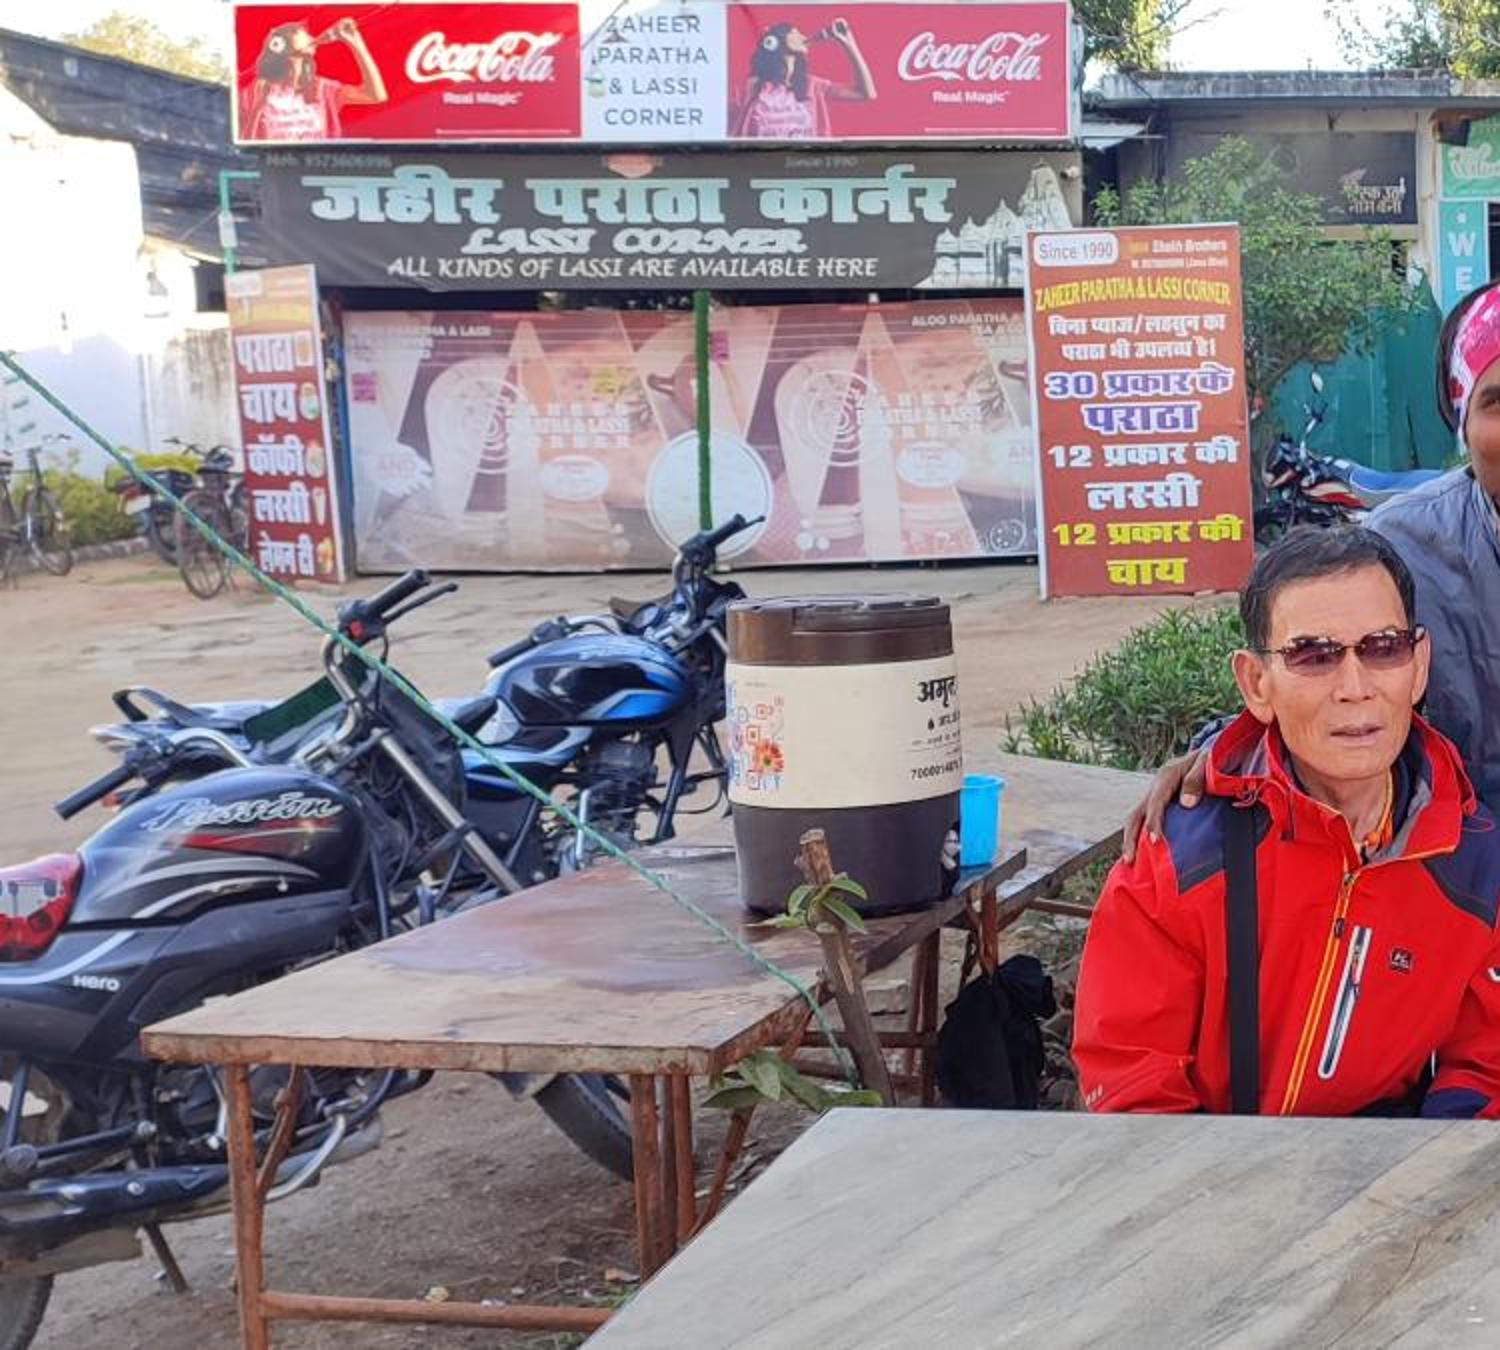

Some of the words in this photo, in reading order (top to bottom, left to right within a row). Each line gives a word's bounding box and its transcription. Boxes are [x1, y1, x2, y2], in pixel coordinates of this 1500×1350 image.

[605, 15, 702, 34] ZAHEER
[405, 31, 567, 84] Coca-Cola
[597, 46, 710, 66] PARATHA
[896, 31, 1052, 82] Coca-Cola
[608, 77, 624, 96] &
[631, 77, 699, 96] LASSI
[932, 90, 962, 104] Real
[603, 107, 704, 127] CORNER
[301, 164, 504, 225] जहीर
[524, 176, 730, 225] पराठा
[750, 163, 957, 224] कार्नर
[461, 227, 597, 255] LASSI
[612, 227, 809, 254] CORNER
[1039, 238, 1077, 260] Since
[1082, 241, 1114, 258] 1990
[387, 257, 432, 278] ALL
[438, 257, 514, 279] KINDS
[519, 257, 553, 278] OF
[558, 257, 623, 278] LASSI
[629, 257, 676, 278] ARE
[681, 256, 810, 278] AVAILABLE
[815, 257, 880, 277] HERE
[1034, 284, 1080, 312] ZAHEER
[1081, 276, 1132, 303] PARATHA
[1133, 277, 1147, 299] &
[1148, 276, 1182, 300] LASSI
[1183, 278, 1232, 305] CORNER
[1047, 313, 1088, 336] बिना
[1203, 313, 1227, 331] का
[234, 332, 295, 374] पराठा
[1110, 338, 1131, 359] भी
[1044, 371, 1098, 399] 30
[1101, 369, 1193, 398] प्रकार
[1196, 361, 1236, 395] के
[239, 383, 298, 424] चाय
[1080, 401, 1202, 435] पराठा
[246, 433, 305, 477] कॉफी
[1048, 445, 1093, 468] 12
[1102, 443, 1190, 467] प्रकार
[1194, 435, 1241, 464] की
[252, 480, 312, 524] लस्सी
[1084, 472, 1203, 510] लस्सी
[1053, 523, 1097, 546] 12
[1106, 521, 1193, 545] प्रकार
[1197, 514, 1245, 541] की
[1106, 557, 1189, 586] चाय
